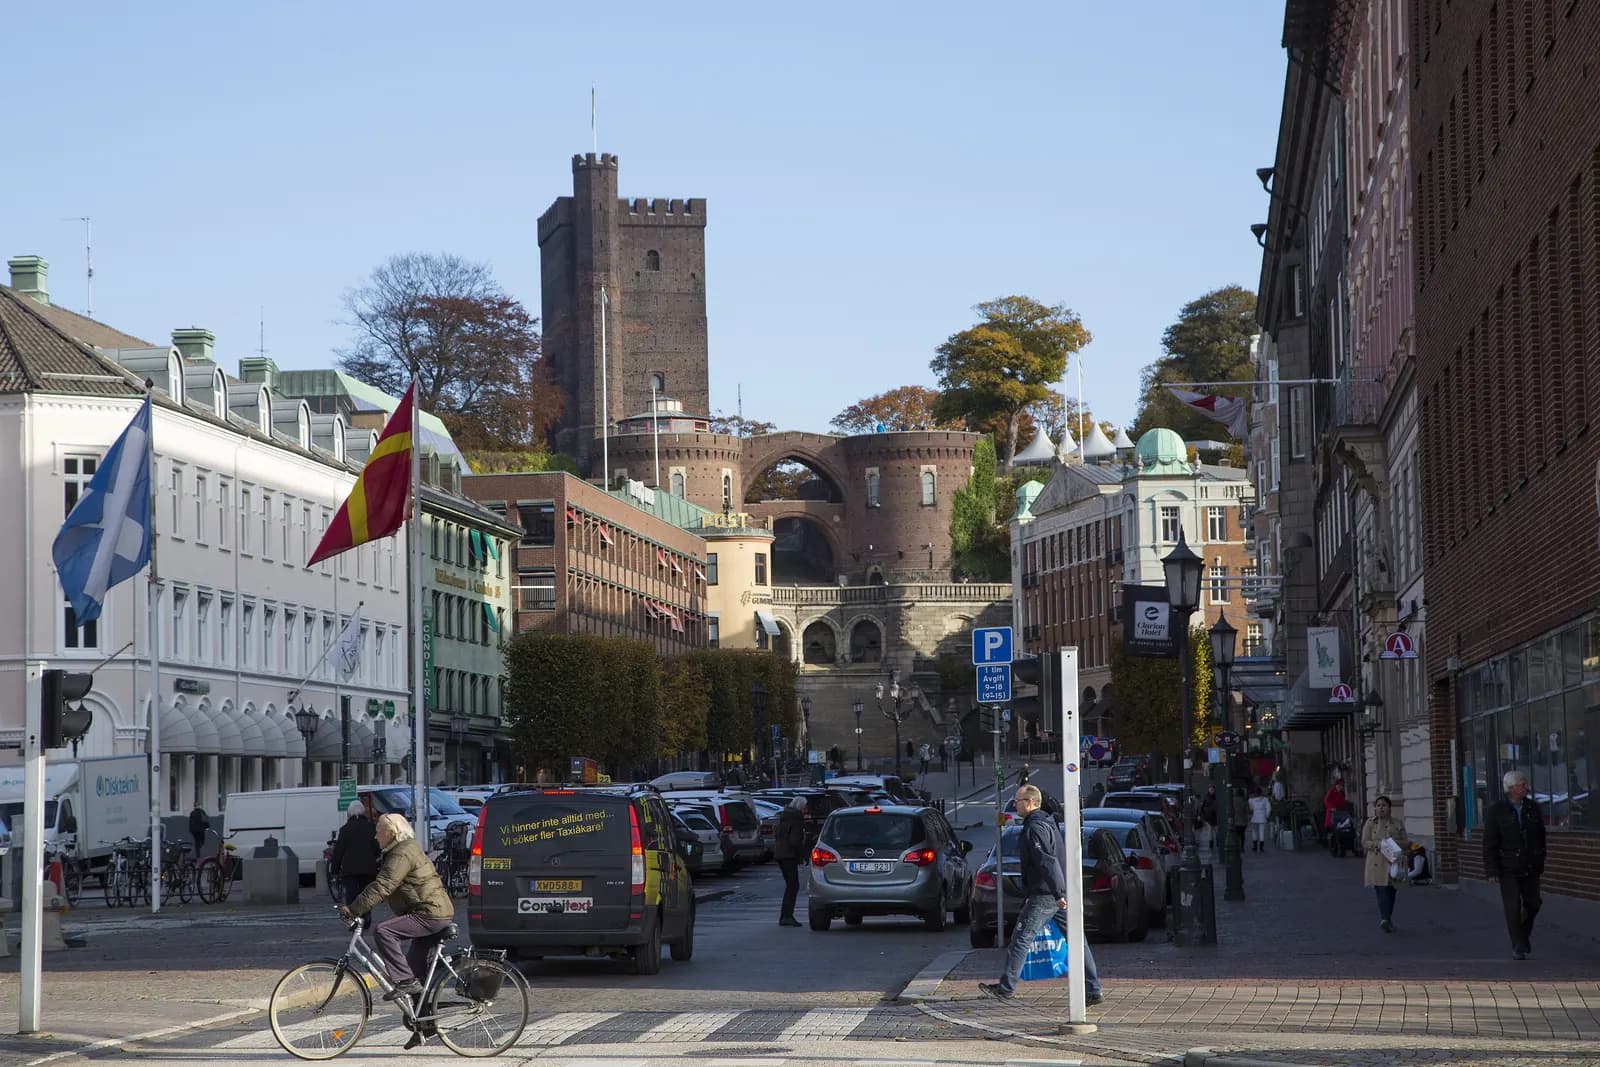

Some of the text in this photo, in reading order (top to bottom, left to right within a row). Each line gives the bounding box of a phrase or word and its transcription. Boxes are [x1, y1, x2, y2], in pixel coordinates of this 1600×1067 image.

[702, 512, 748, 529] POST
[1137, 622, 1166, 631] Clarion
[984, 631, 1004, 661] P
[983, 675, 1005, 684] Avgift
[500, 809, 614, 835] Vi hinner inte alltid med...
[501, 821, 604, 846] Vi söker fler Taxiåkare!
[536, 881, 574, 890] XWD588
[520, 898, 592, 913] Combitext
